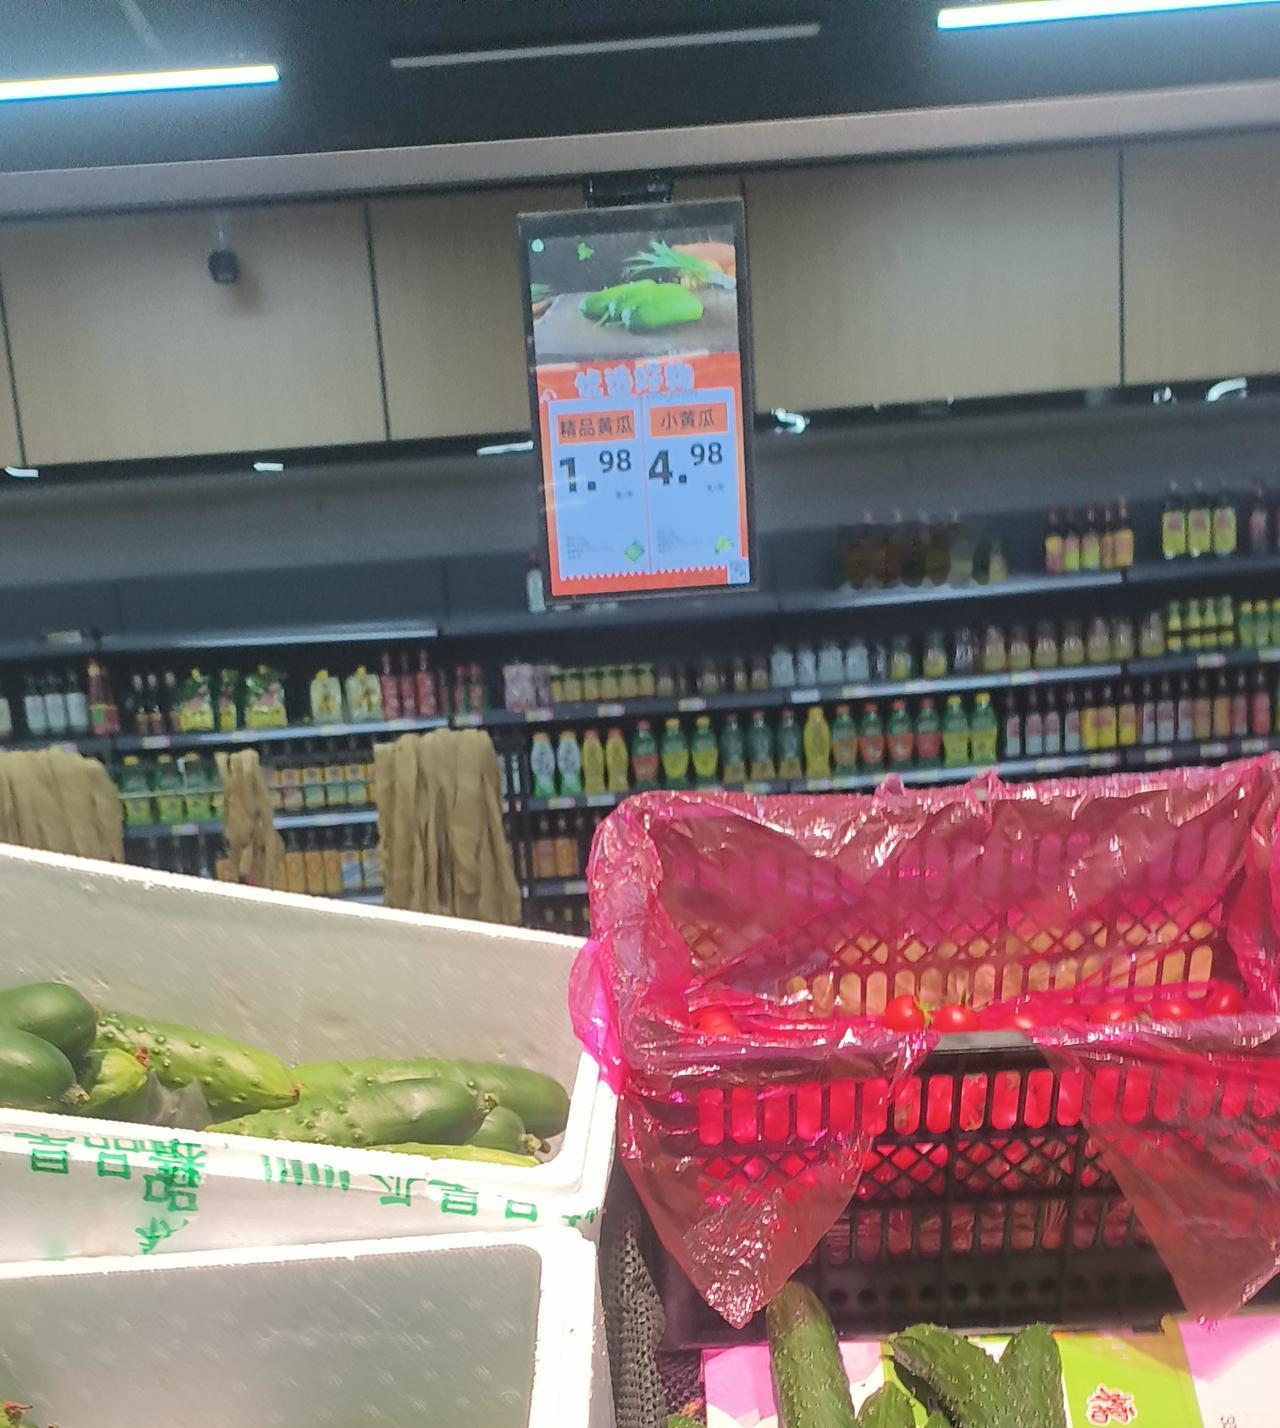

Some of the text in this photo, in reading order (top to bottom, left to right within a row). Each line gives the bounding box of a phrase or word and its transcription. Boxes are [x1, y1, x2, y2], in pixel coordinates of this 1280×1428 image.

[560, 415, 633, 439] 精品黄瓜
[661, 409, 716, 432] 小黄瓜
